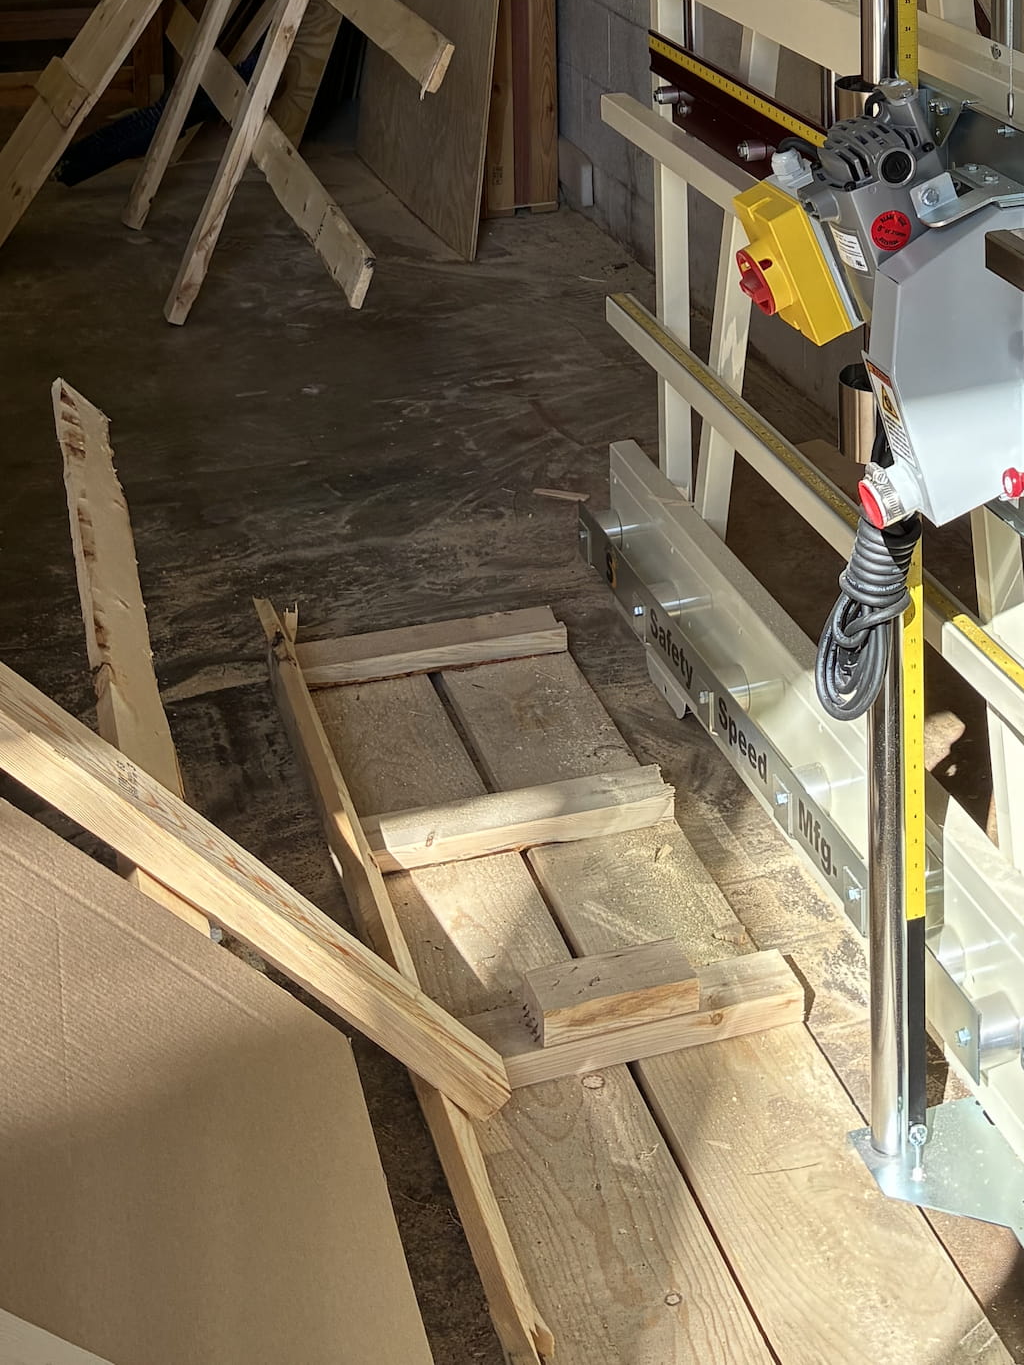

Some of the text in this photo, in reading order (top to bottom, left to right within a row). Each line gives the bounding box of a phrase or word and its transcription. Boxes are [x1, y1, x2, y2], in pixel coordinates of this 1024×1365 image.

[650, 607, 838, 876] Safety Speed Mfg.
